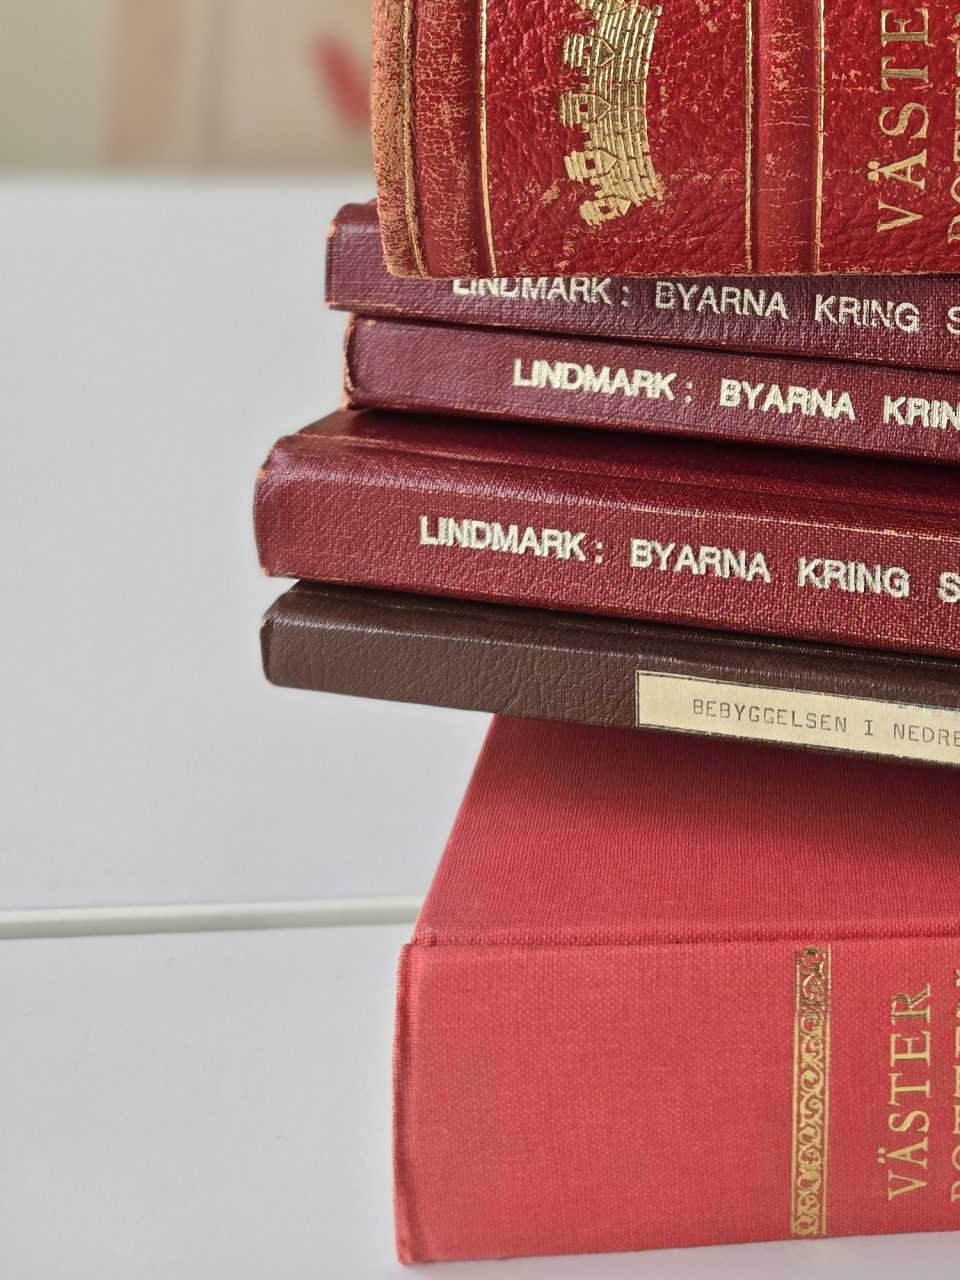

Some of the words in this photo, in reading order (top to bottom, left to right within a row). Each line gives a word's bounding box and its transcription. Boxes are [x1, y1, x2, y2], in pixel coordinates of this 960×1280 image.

[654, 280, 788, 320] BYARNA
[813, 294, 920, 334] KRING
[718, 378, 857, 421] BYARNA
[629, 538, 772, 583] BYARNA
[797, 556, 911, 598] KRING
[691, 698, 848, 736] BEBYGGELSEN
[862, 718, 875, 738] I
[877, 982, 931, 1202] VÄSTER
